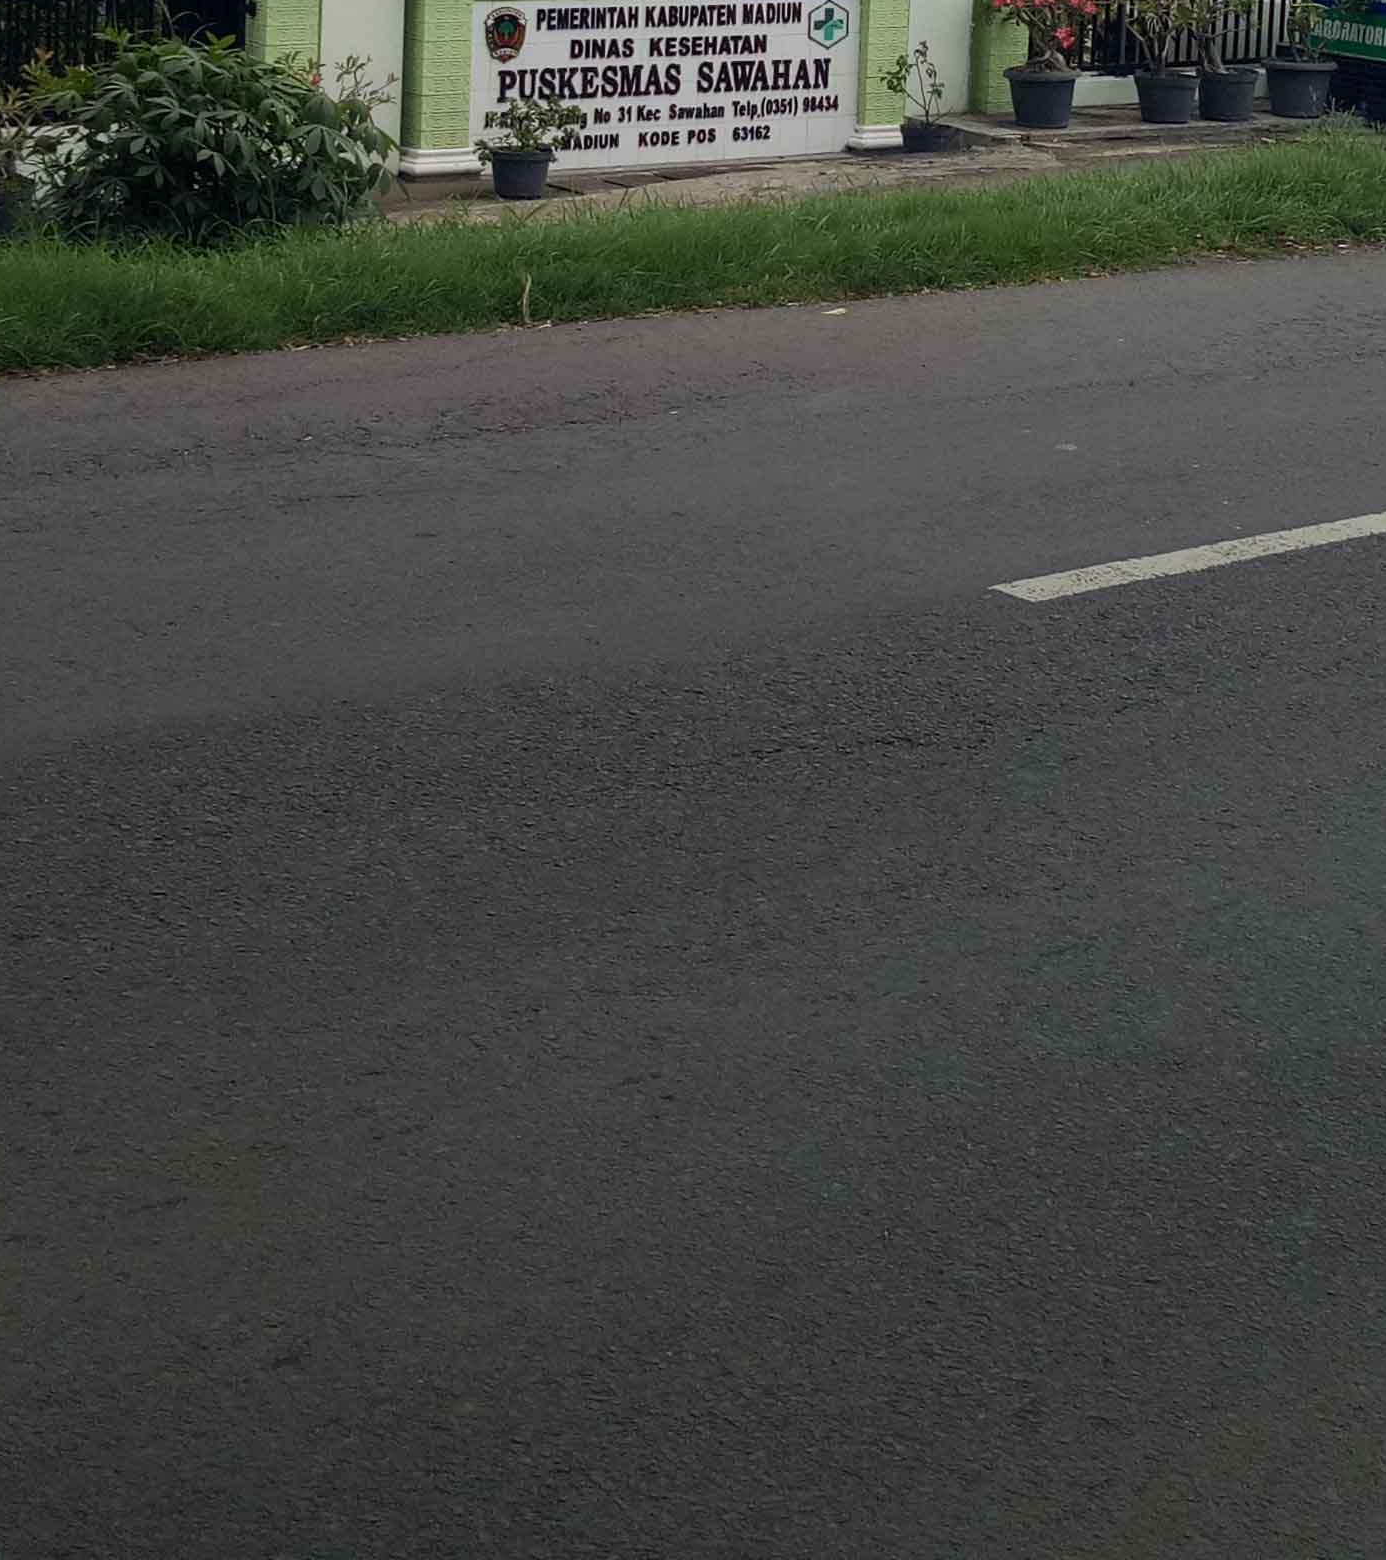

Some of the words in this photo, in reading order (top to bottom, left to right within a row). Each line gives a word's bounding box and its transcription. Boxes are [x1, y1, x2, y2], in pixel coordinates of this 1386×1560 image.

[535, 6, 639, 31] PEMERINTAH
[645, 3, 737, 28] KABUPATEN
[742, 1, 802, 25] MADIUN
[569, 38, 634, 59] DINAS
[649, 34, 768, 57] KESEHATAN
[497, 63, 682, 104] PUSKESMAS
[696, 57, 832, 93] SAWAHAN
[593, 107, 611, 125] No
[617, 107, 633, 124] 31
[636, 105, 662, 122] Kec
[668, 103, 725, 121] Sawahan
[802, 95, 839, 114] 98434
[638, 130, 681, 148] KODE
[687, 128, 717, 145] POS
[732, 124, 771, 142] 63162
